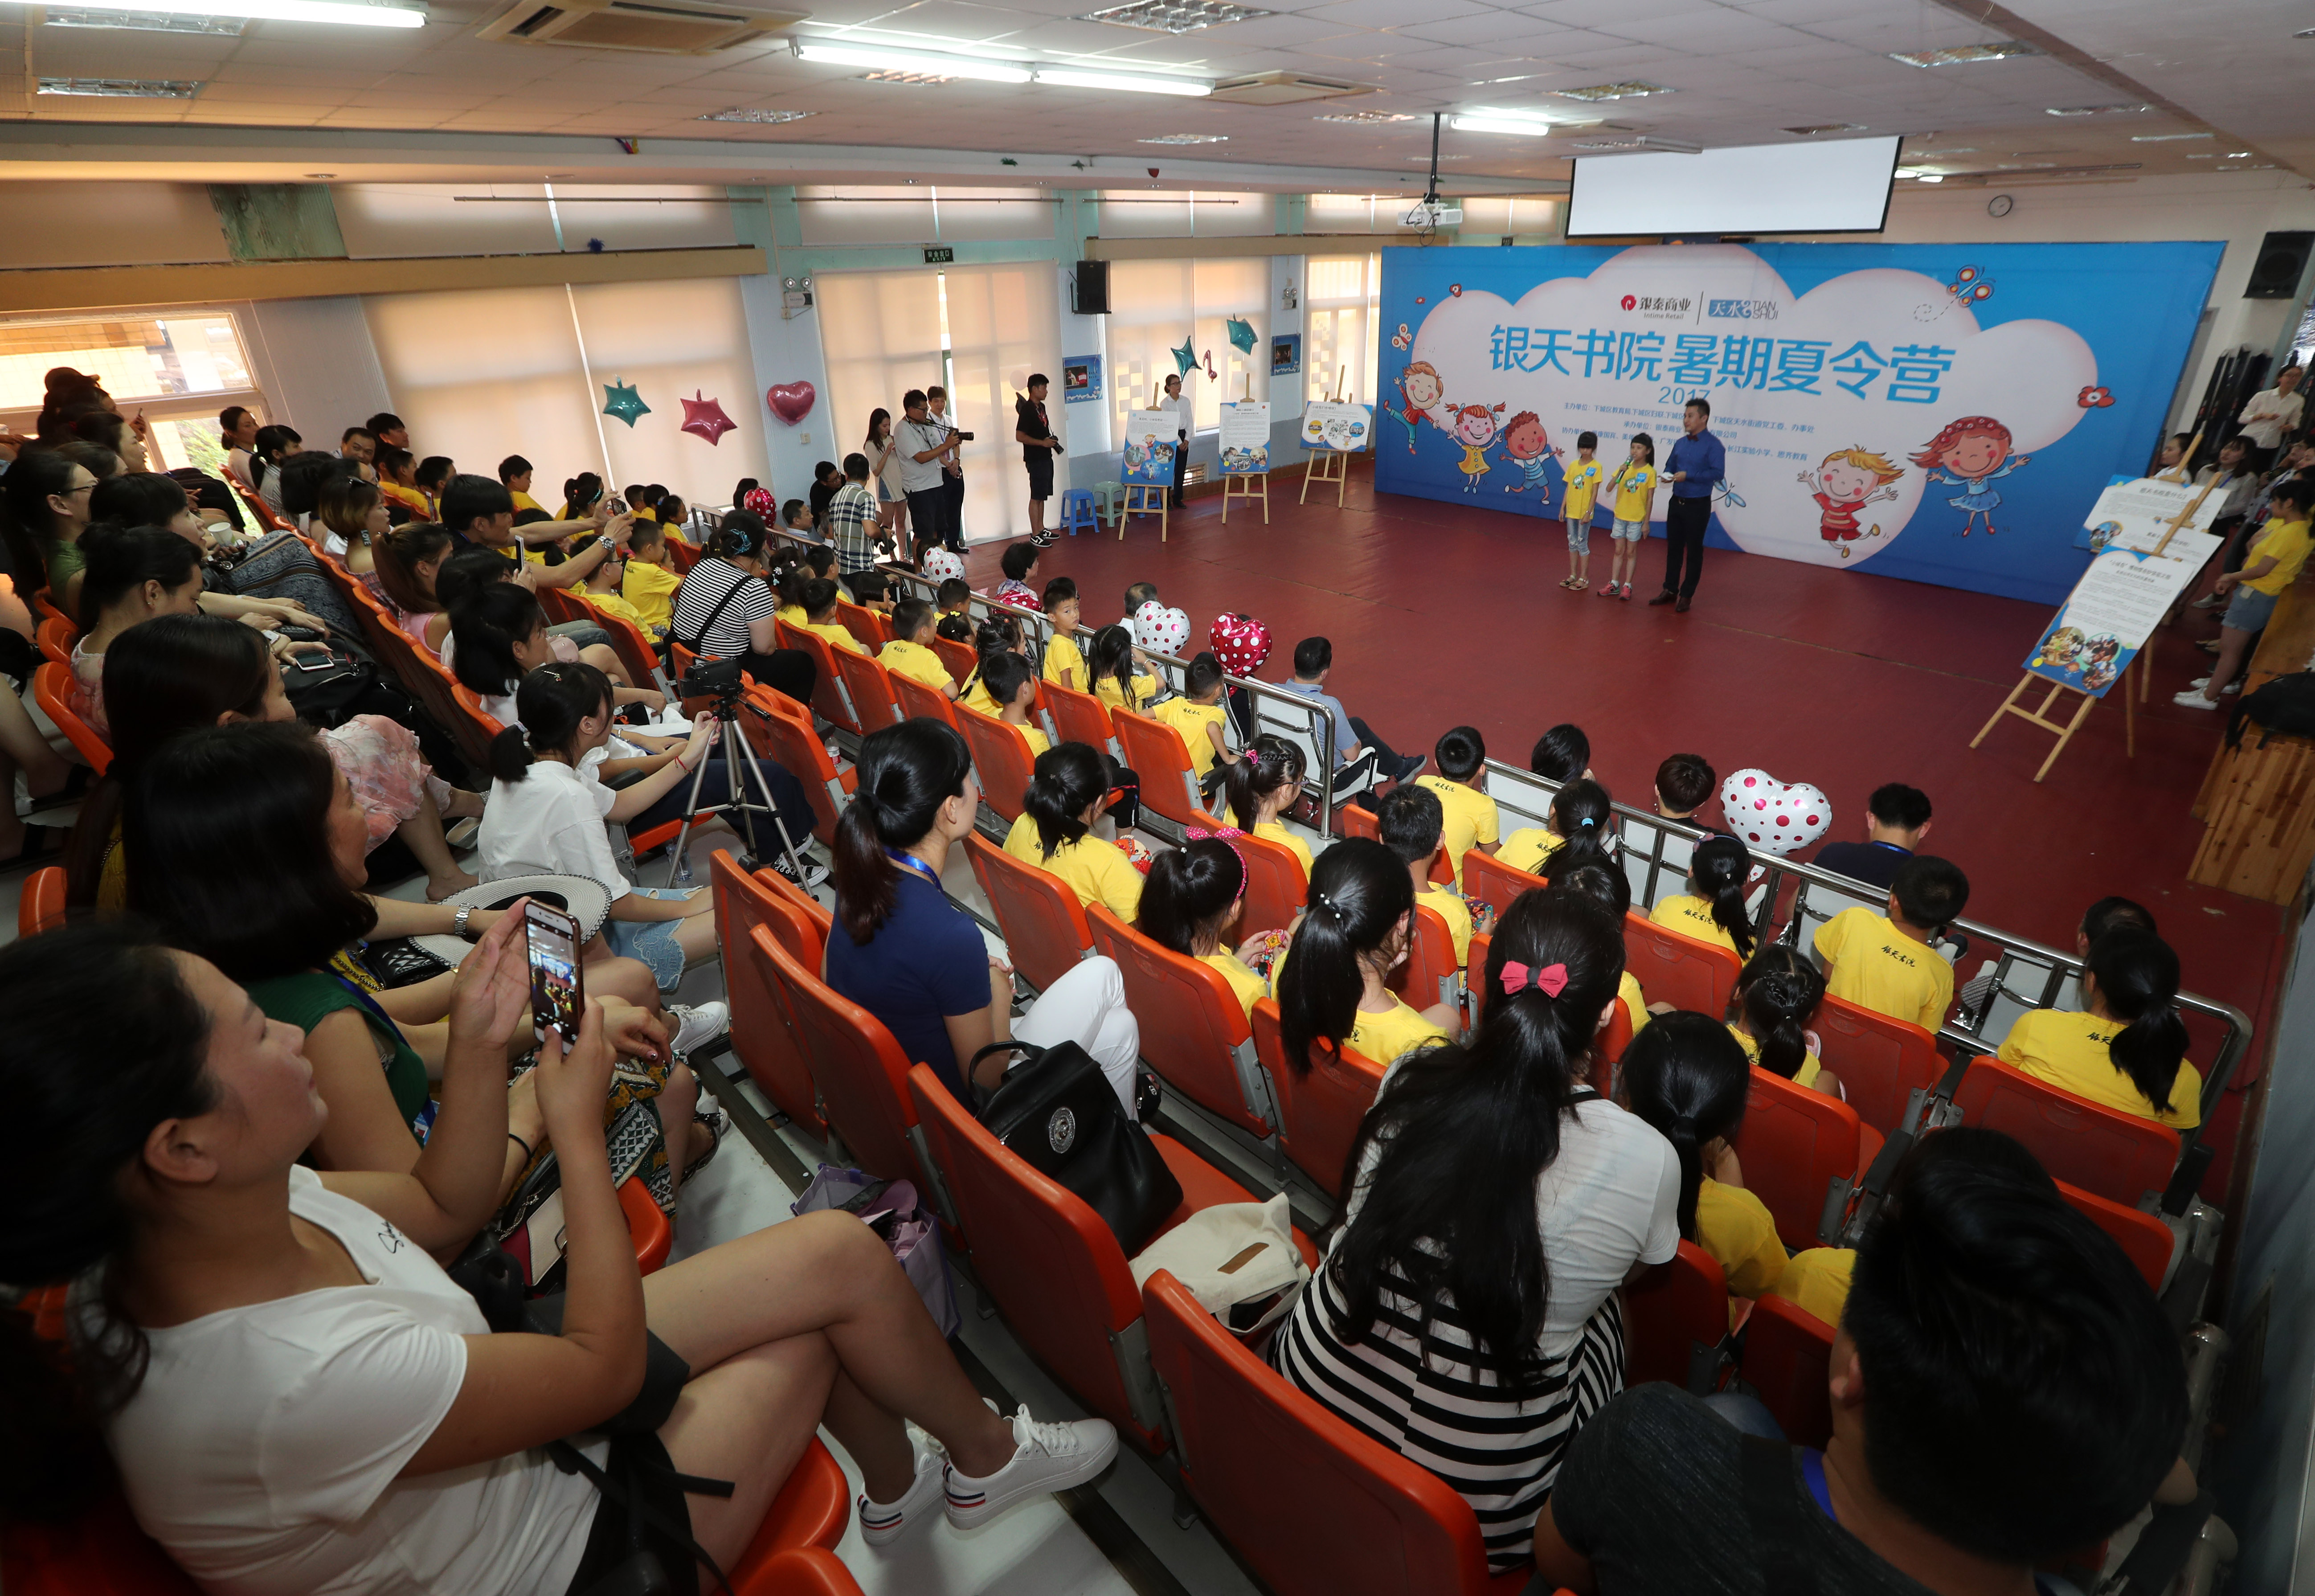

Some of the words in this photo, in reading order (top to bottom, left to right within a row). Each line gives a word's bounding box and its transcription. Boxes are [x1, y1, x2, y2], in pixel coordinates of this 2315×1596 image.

[1640, 297, 1692, 311] 银泰商业
[1712, 301, 1741, 317] 天水
[1752, 301, 1776, 311] TIAN
[1752, 310, 1779, 320] SHUI
[361, 530, 372, 546] LOVE
[2086, 1031, 2111, 1045] 银天
